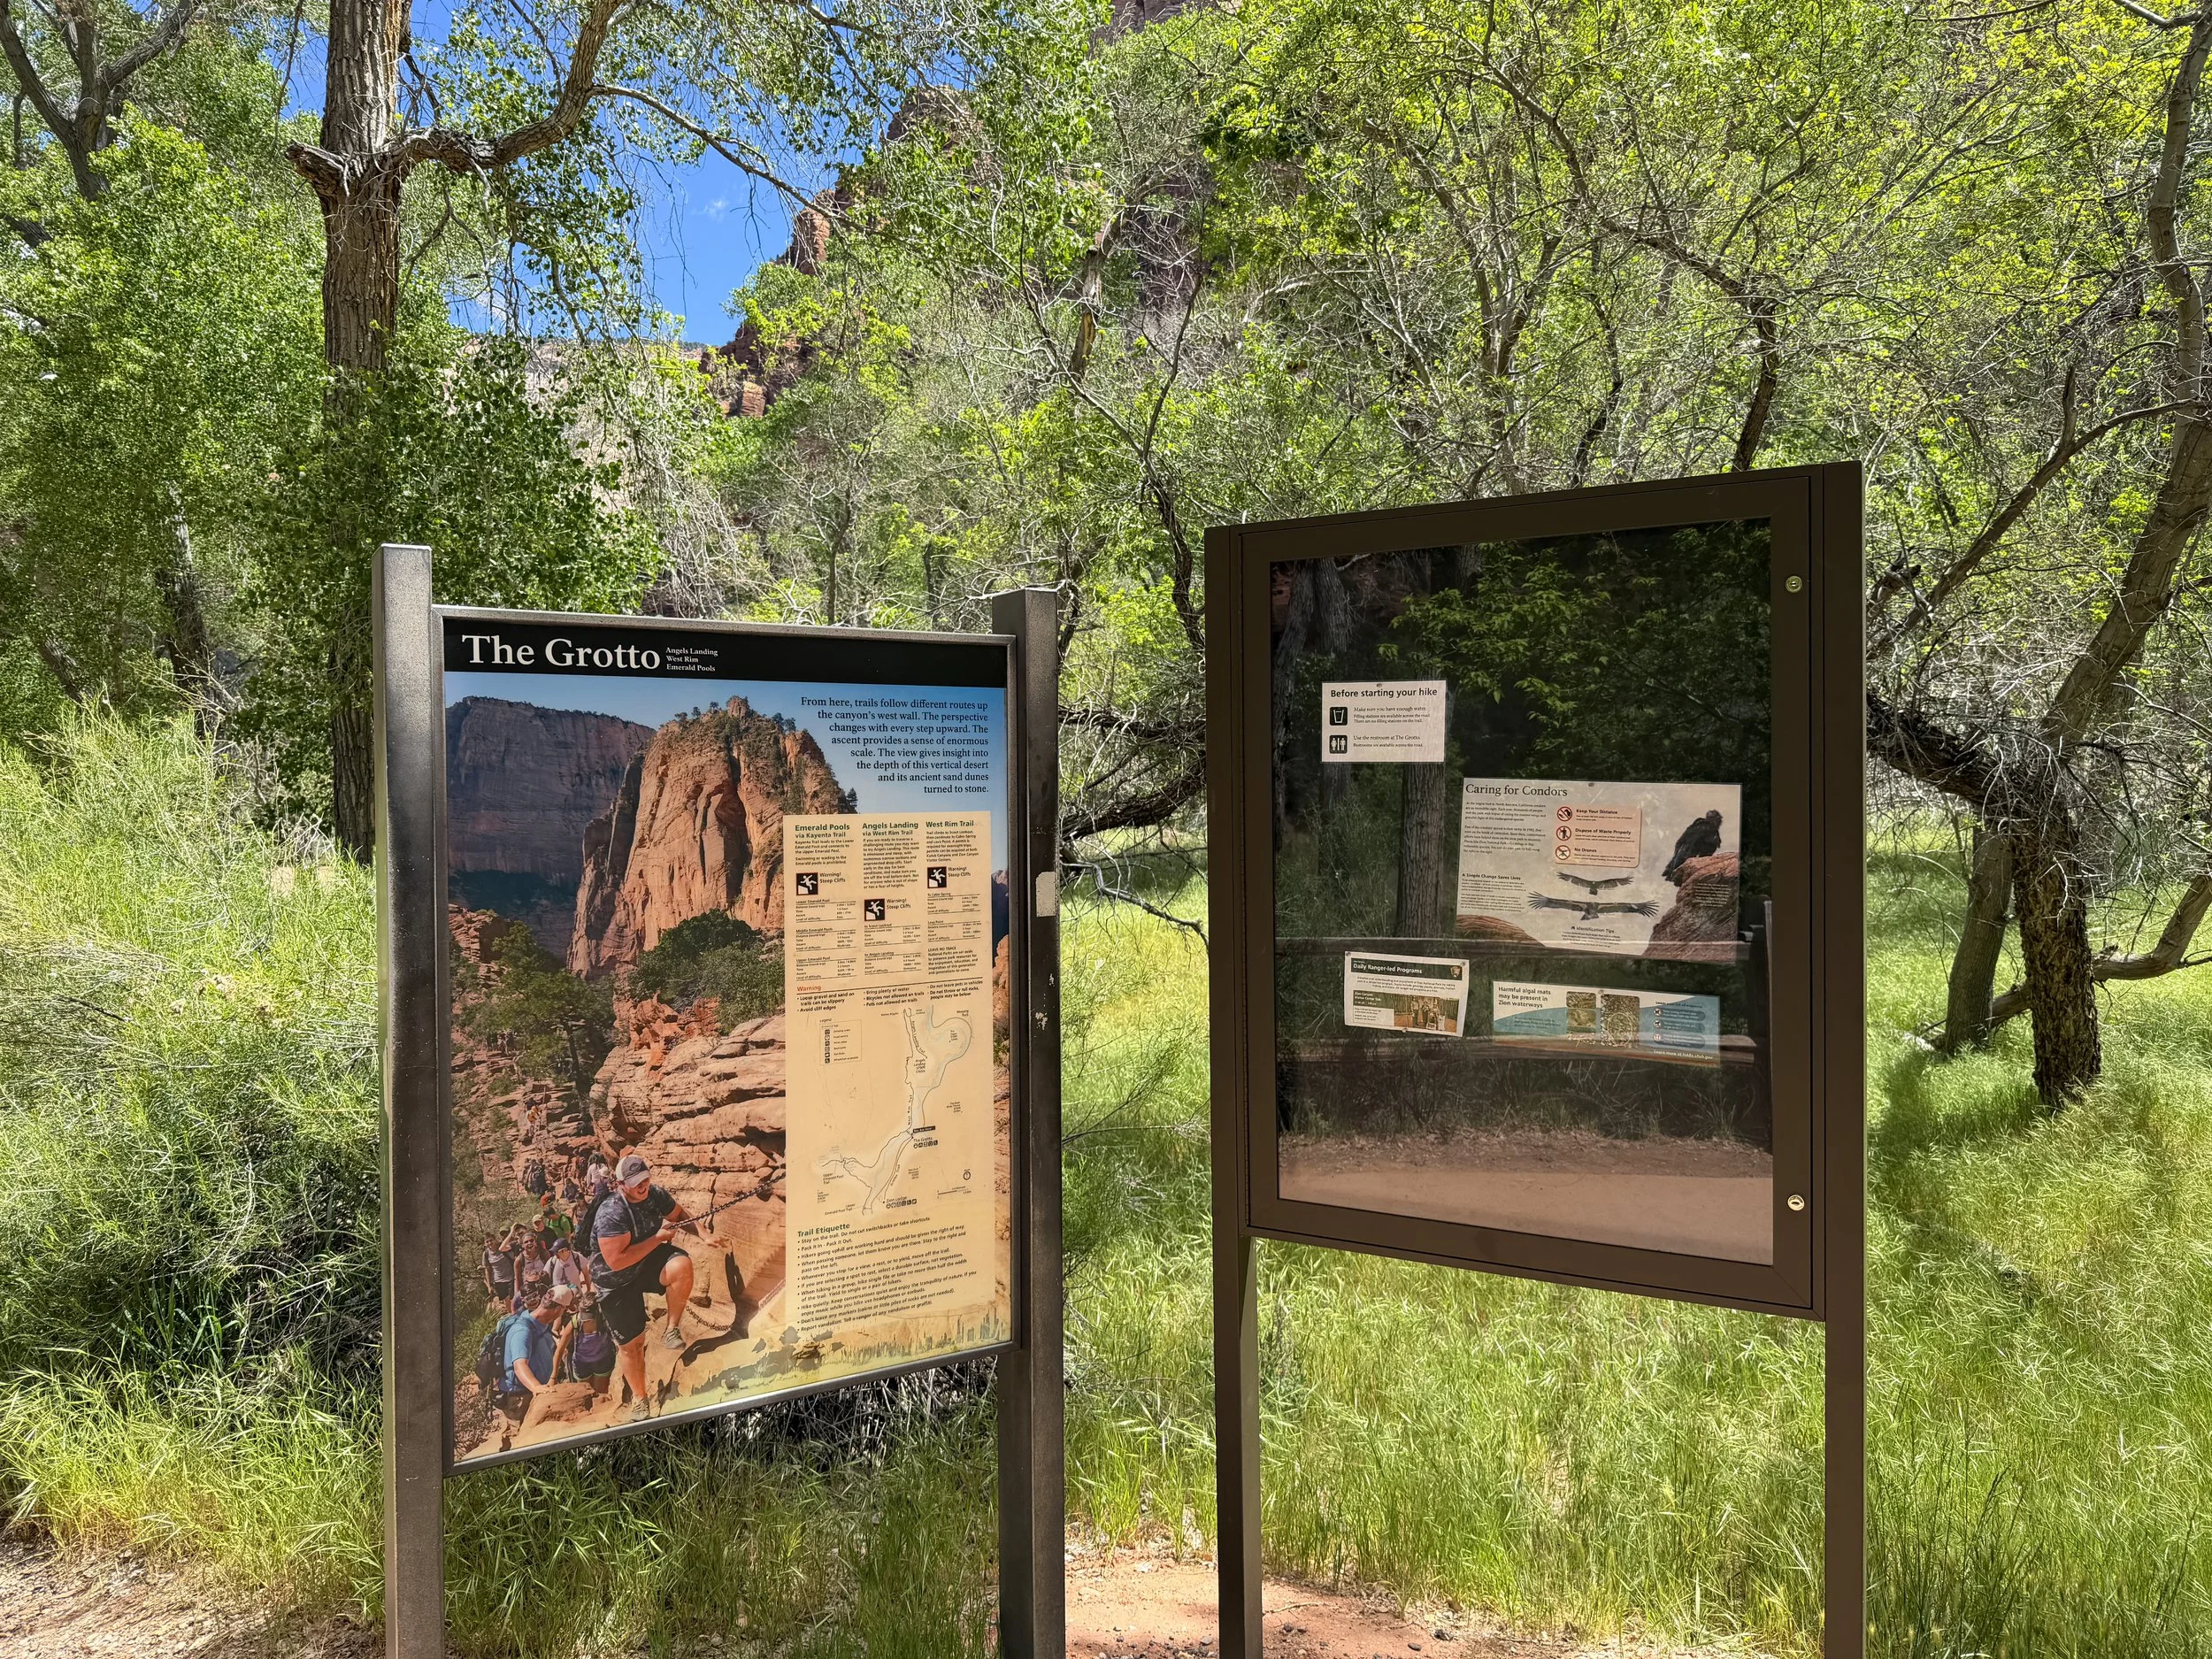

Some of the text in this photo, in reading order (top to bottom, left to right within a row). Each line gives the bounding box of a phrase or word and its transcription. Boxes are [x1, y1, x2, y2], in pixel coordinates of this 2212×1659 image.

[462, 634, 659, 669] The Grotto
[690, 648, 718, 657] Landing
[1361, 688, 1394, 697] starting
[1396, 689, 1417, 698] your
[829, 697, 852, 708] here,
[855, 698, 878, 707] trails
[910, 699, 947, 708] different
[834, 710, 875, 720] canyon’s
[941, 712, 987, 721] perspective
[829, 724, 865, 733] changes
[916, 725, 933, 733] step
[936, 726, 971, 734] upward.
[863, 737, 901, 746] provides
[873, 761, 898, 770] depth
[1465, 784, 1567, 798] Caring for Condors
[816, 1224, 849, 1233] Etiquette
